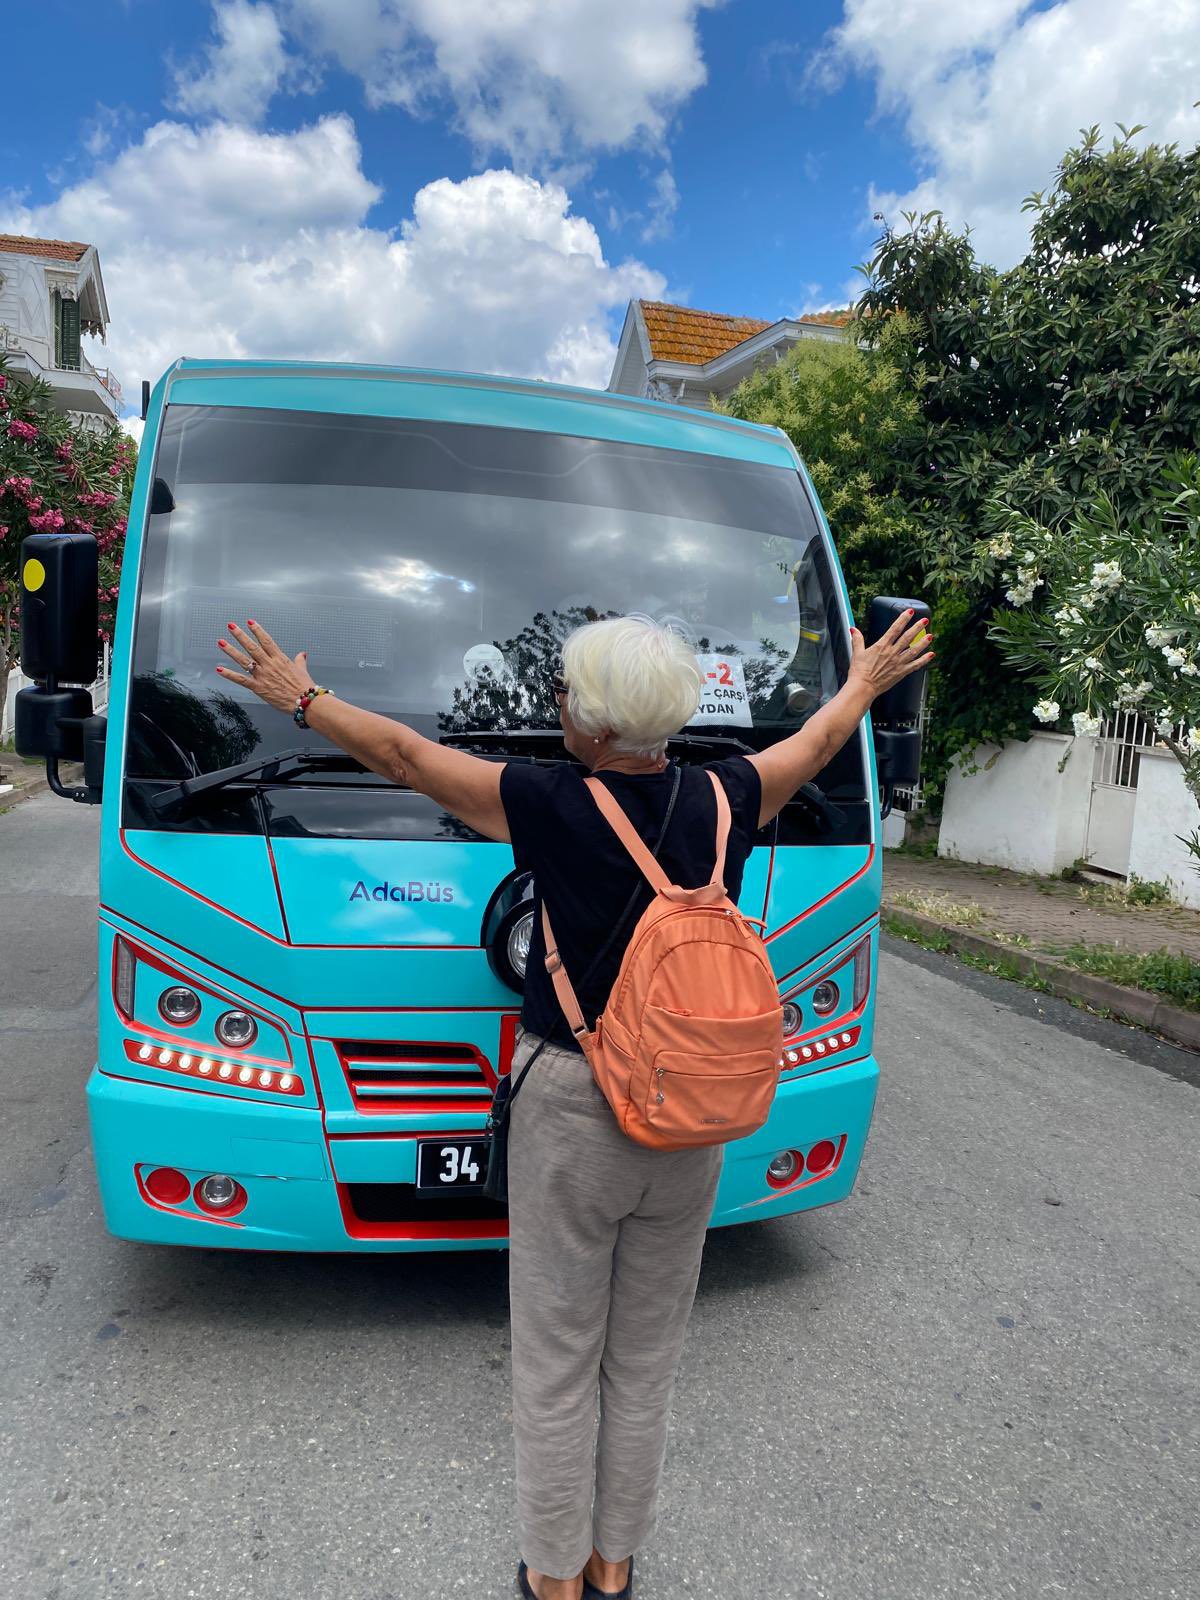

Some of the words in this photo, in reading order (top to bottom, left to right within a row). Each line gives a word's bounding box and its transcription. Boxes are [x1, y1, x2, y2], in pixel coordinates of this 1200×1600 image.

[697, 703, 734, 714] YDAN
[349, 880, 454, 902] AdaBüs
[439, 1146, 479, 1182] 34
